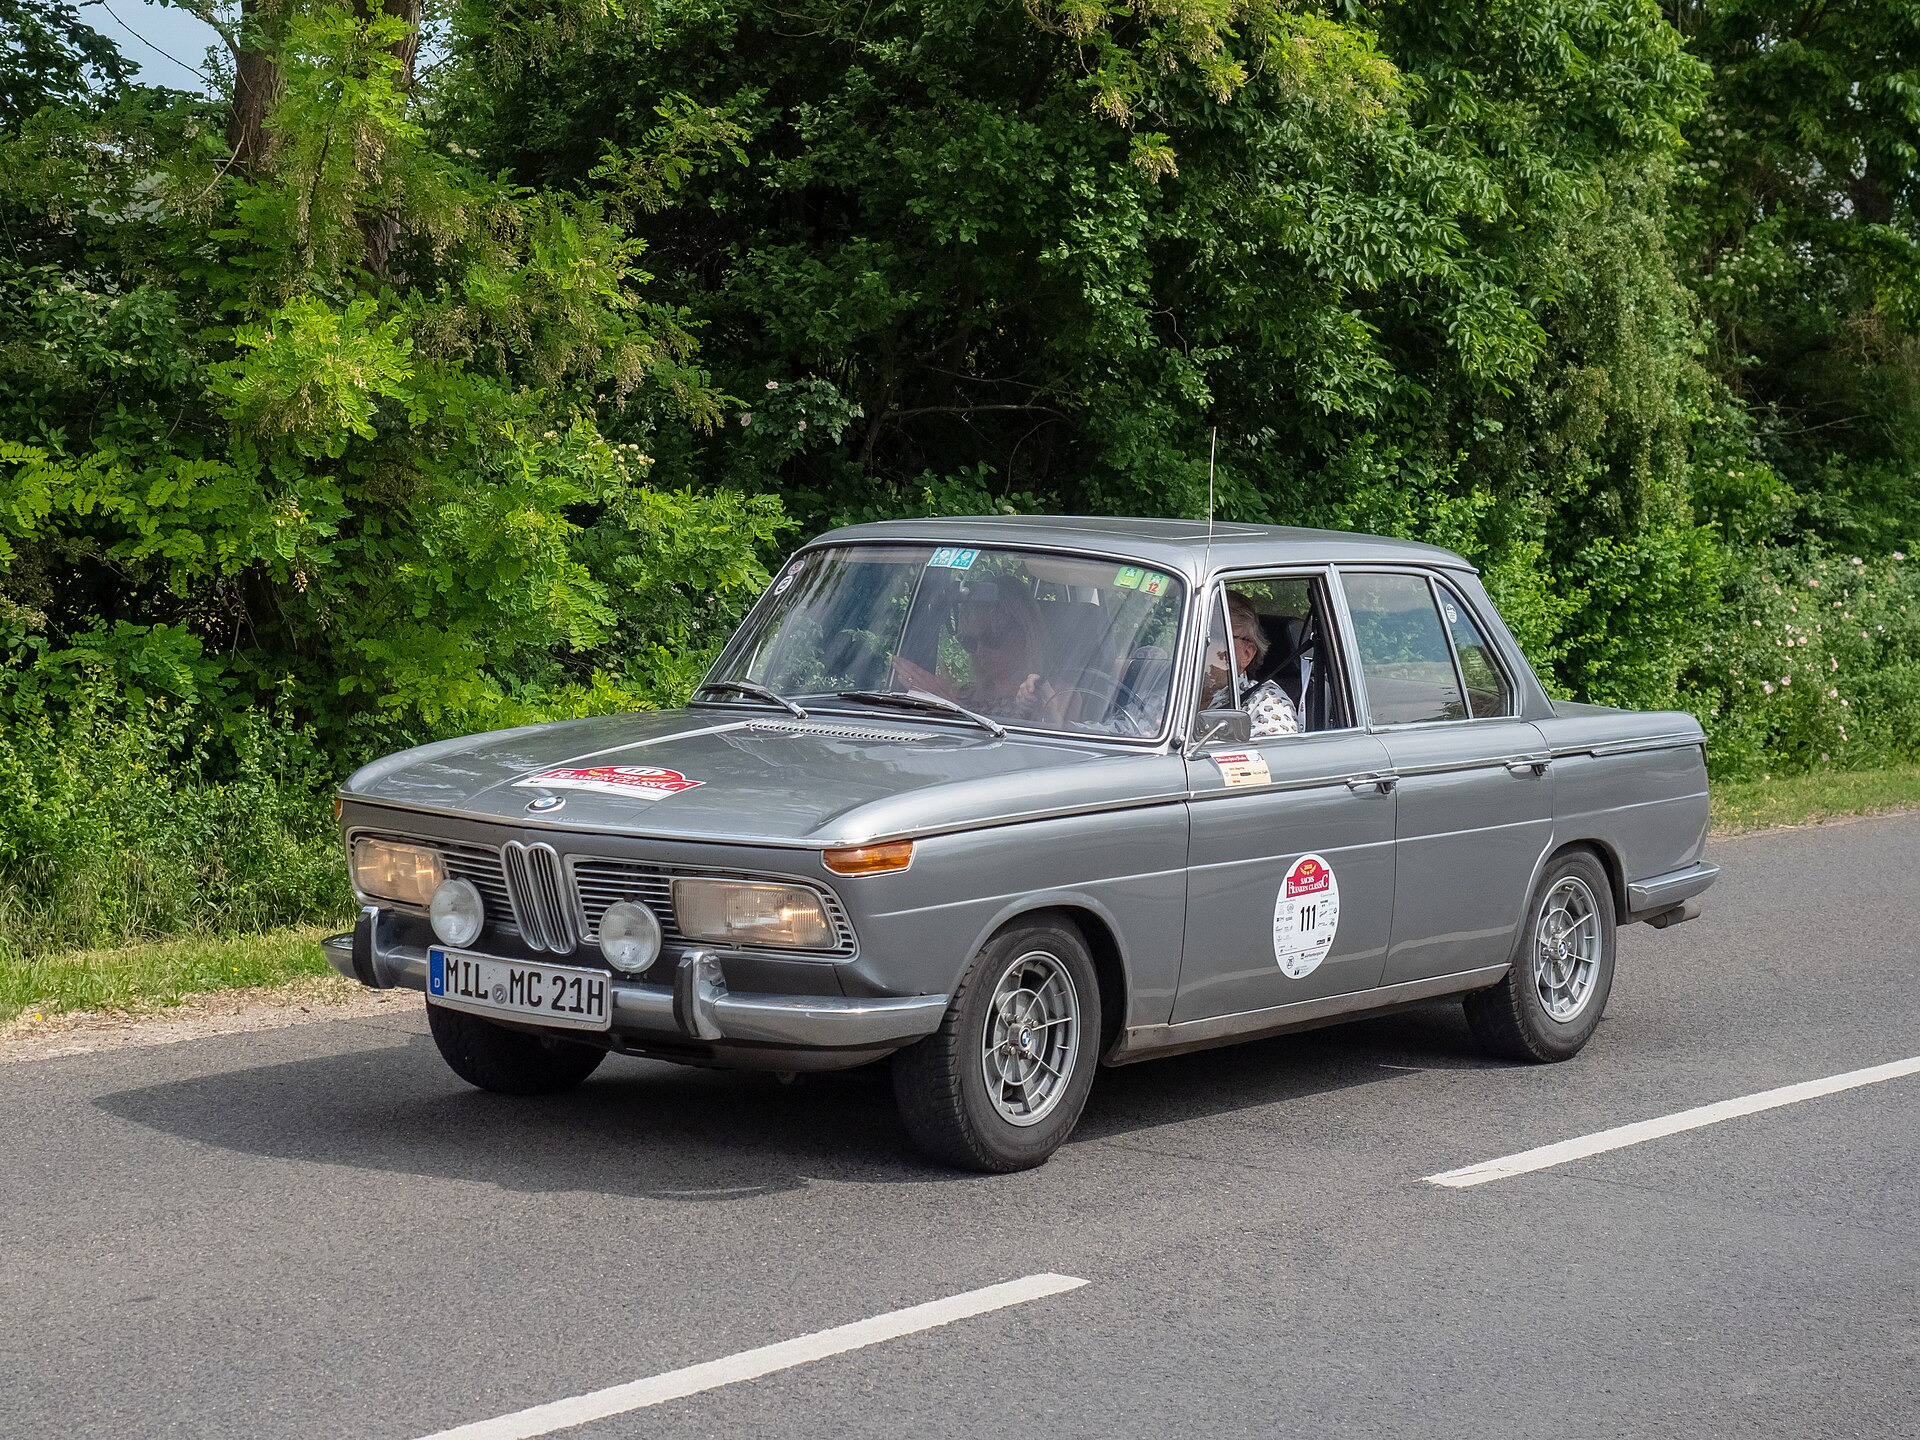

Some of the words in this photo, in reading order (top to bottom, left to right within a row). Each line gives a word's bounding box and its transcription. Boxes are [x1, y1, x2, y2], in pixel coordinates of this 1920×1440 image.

[1300, 904, 1316, 932] 111
[434, 977, 441, 988] D
[445, 957, 488, 1000] MIL
[509, 968, 542, 1007] MC
[551, 975, 604, 1016] 21H
